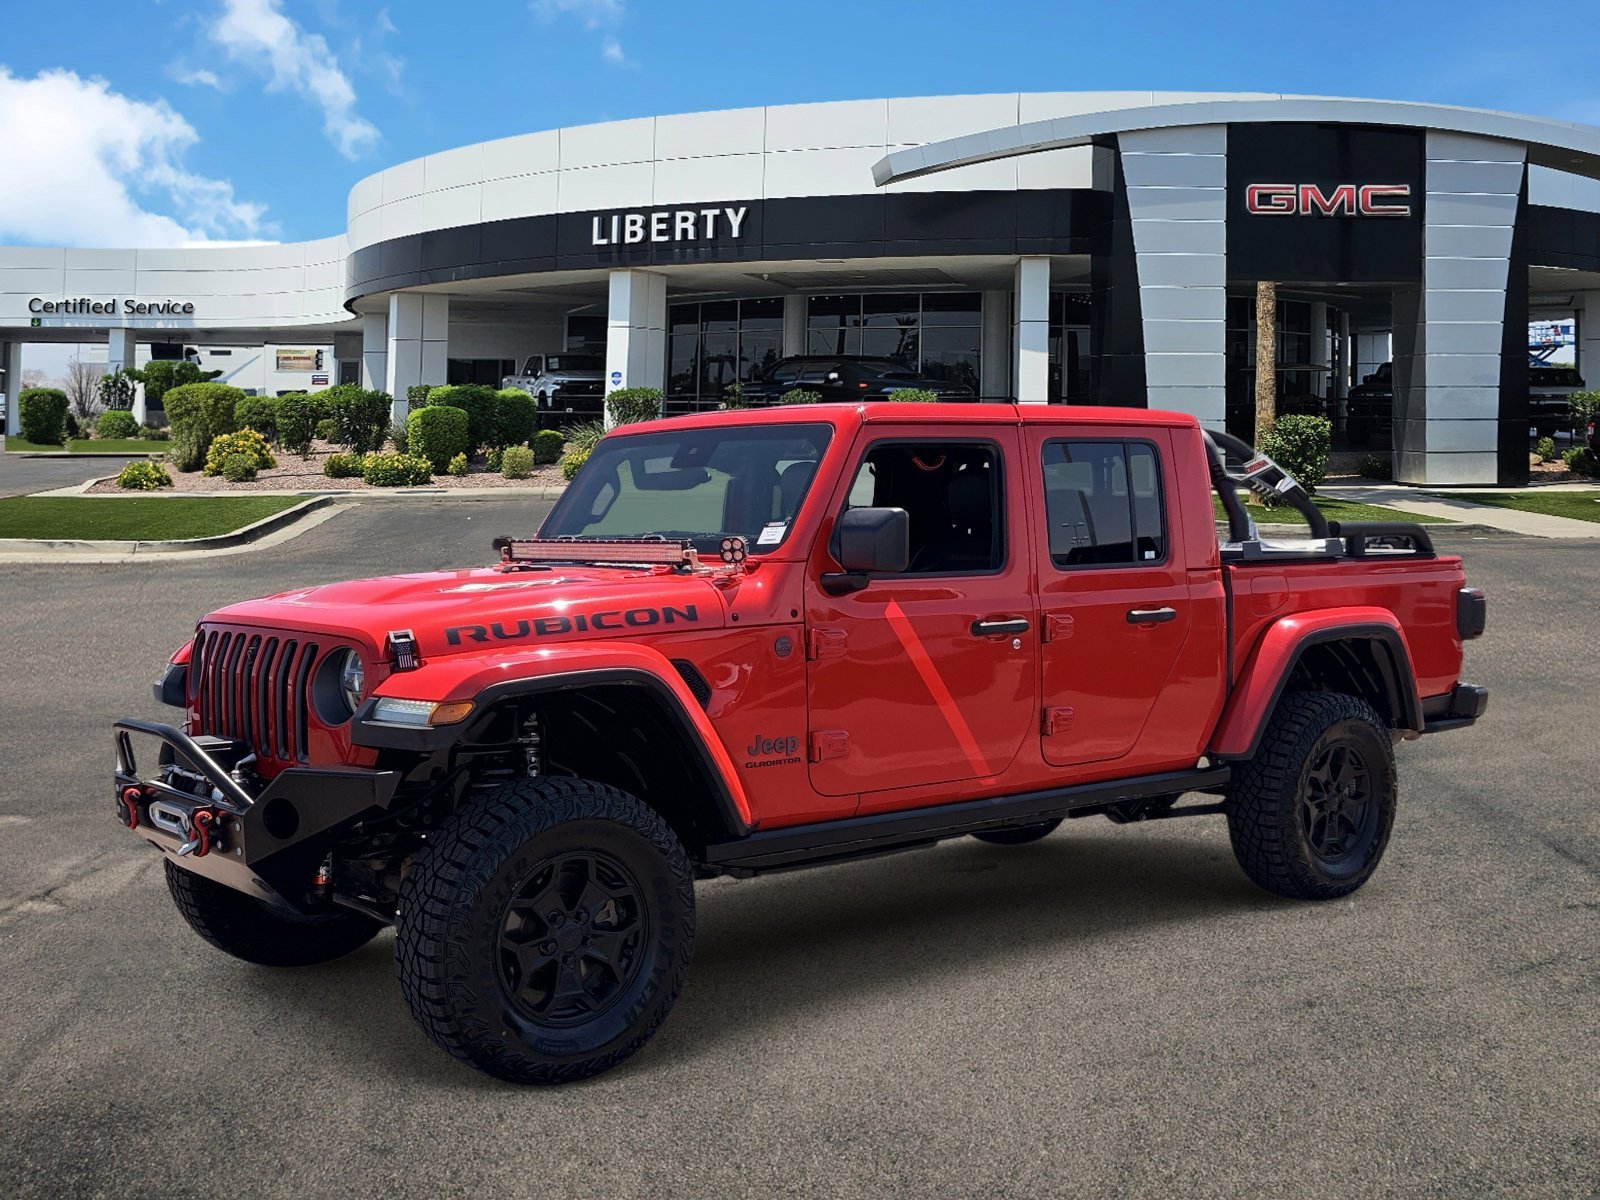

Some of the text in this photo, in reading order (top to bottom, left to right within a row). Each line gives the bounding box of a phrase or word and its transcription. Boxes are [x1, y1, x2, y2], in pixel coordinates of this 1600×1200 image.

[1246, 184, 1411, 217] GMC
[592, 206, 748, 246] LIBERTY
[28, 297, 195, 315] Certified Service
[445, 604, 698, 646] RUBICON
[748, 735, 798, 756] Jeep
[745, 757, 801, 769] GLADIATOR
